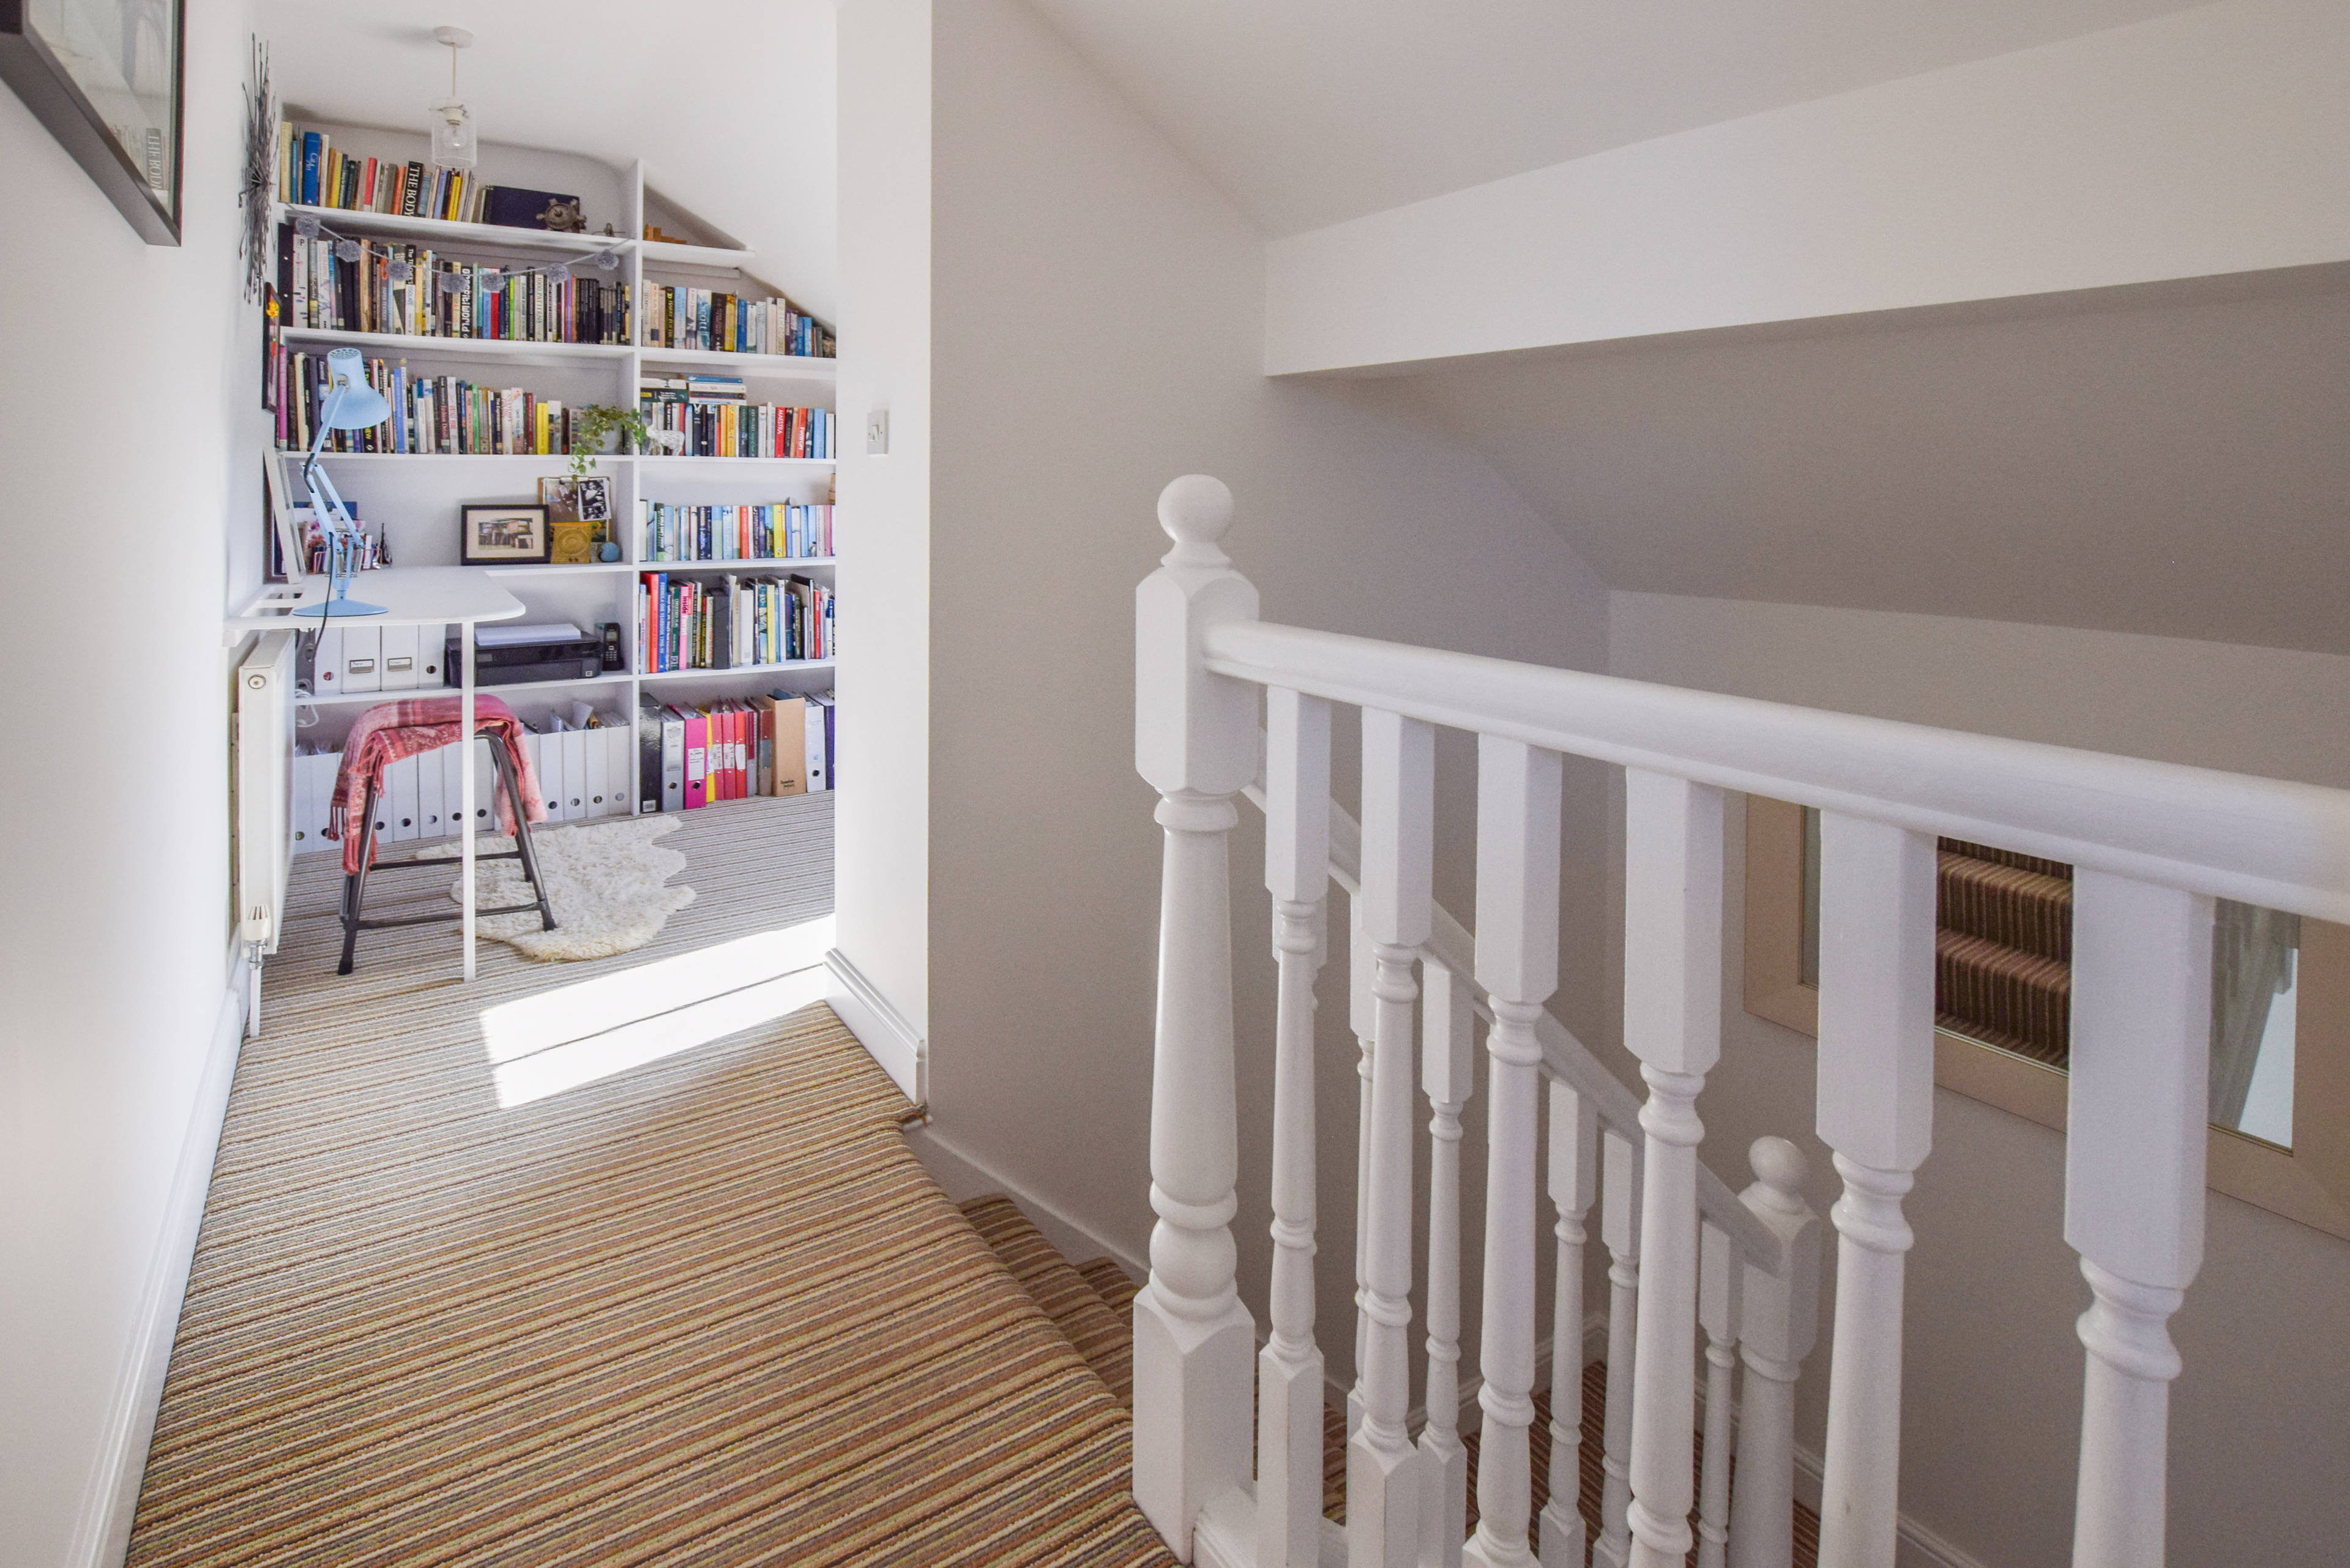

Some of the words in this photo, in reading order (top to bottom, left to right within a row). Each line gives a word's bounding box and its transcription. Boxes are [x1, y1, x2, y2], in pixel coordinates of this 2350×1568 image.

[408, 166, 420, 189] THE
[405, 190, 417, 217] BODY
[699, 302, 708, 330] Scott
